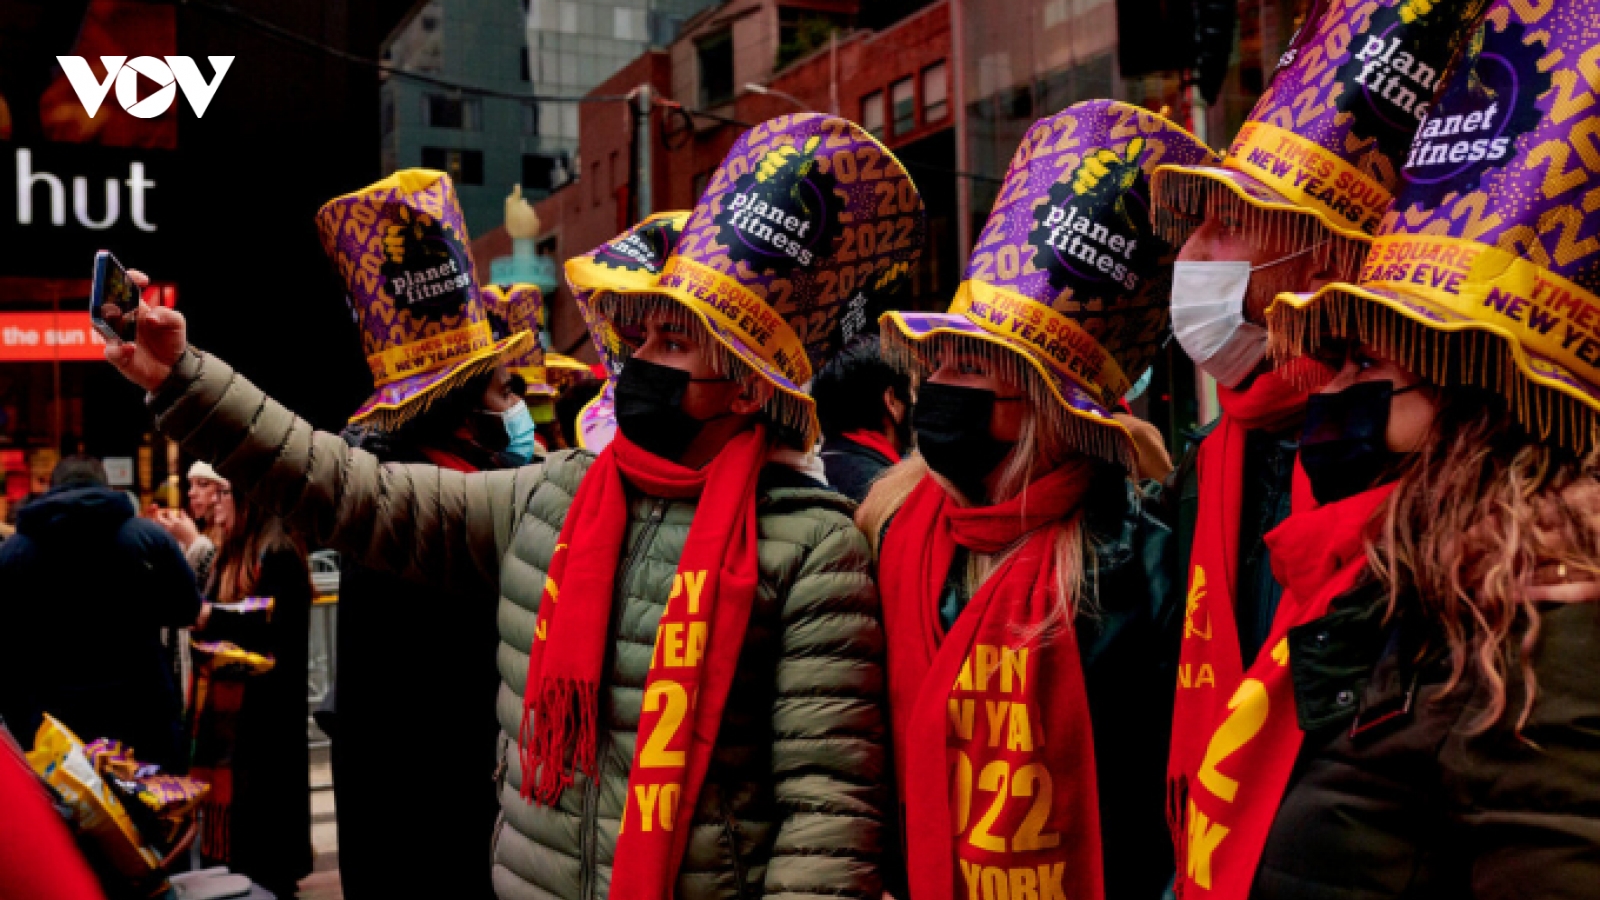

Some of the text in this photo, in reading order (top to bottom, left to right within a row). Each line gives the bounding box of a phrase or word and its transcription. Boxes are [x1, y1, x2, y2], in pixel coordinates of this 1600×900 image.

[1354, 34, 1441, 93] plan
[1353, 60, 1433, 121] fitne
[1411, 101, 1498, 143] lanet
[1404, 137, 1511, 168] itness
[16, 149, 157, 232] hut
[1247, 147, 1362, 222] NEW YEARS
[727, 192, 811, 239] planet
[727, 210, 813, 266] fitness
[1042, 205, 1138, 260] planet
[391, 258, 458, 296] planet
[1045, 226, 1139, 291] fitness
[1361, 263, 1467, 294] EARS EVE
[1384, 242, 1478, 272] SQUARE
[686, 281, 741, 321] YEARS
[1484, 286, 1560, 335] NEW
[3, 326, 40, 345] the
[1012, 317, 1070, 363] YEARS
